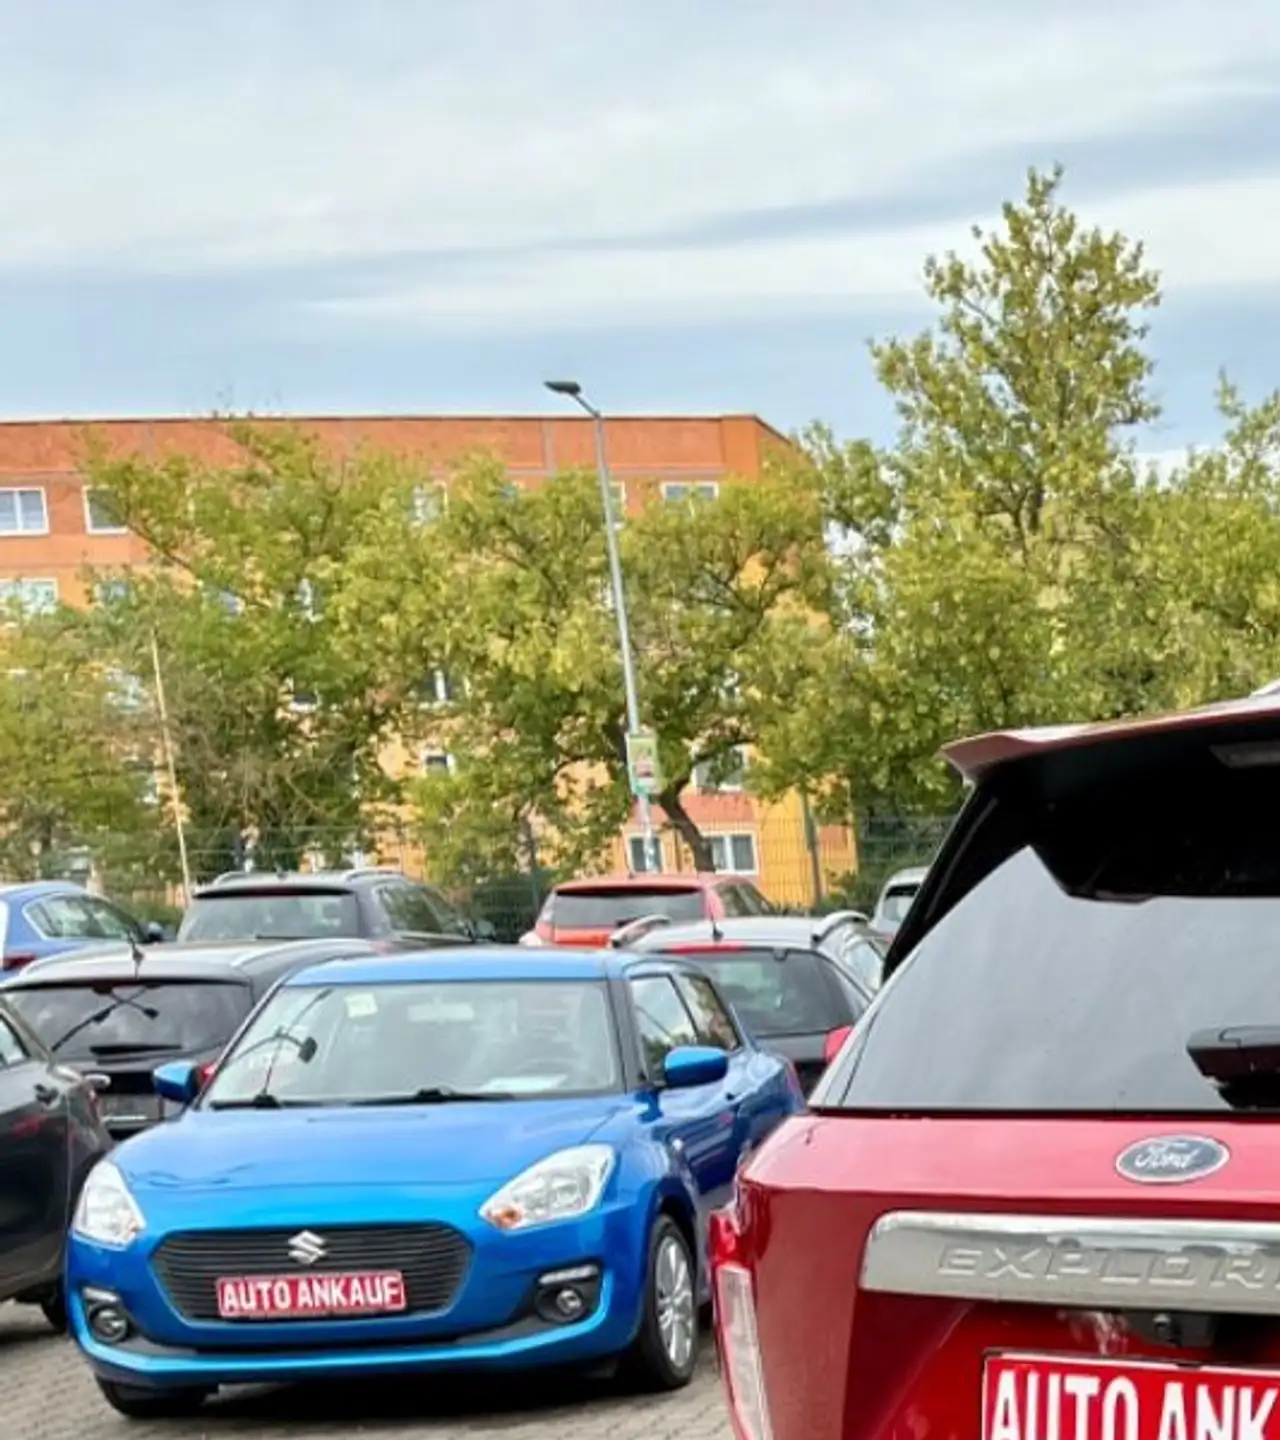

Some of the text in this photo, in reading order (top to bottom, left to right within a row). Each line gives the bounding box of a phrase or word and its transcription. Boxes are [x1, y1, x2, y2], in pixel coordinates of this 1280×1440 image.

[1134, 1142, 1203, 1169] Ford
[223, 1275, 400, 1312] AUTO ANKAUF
